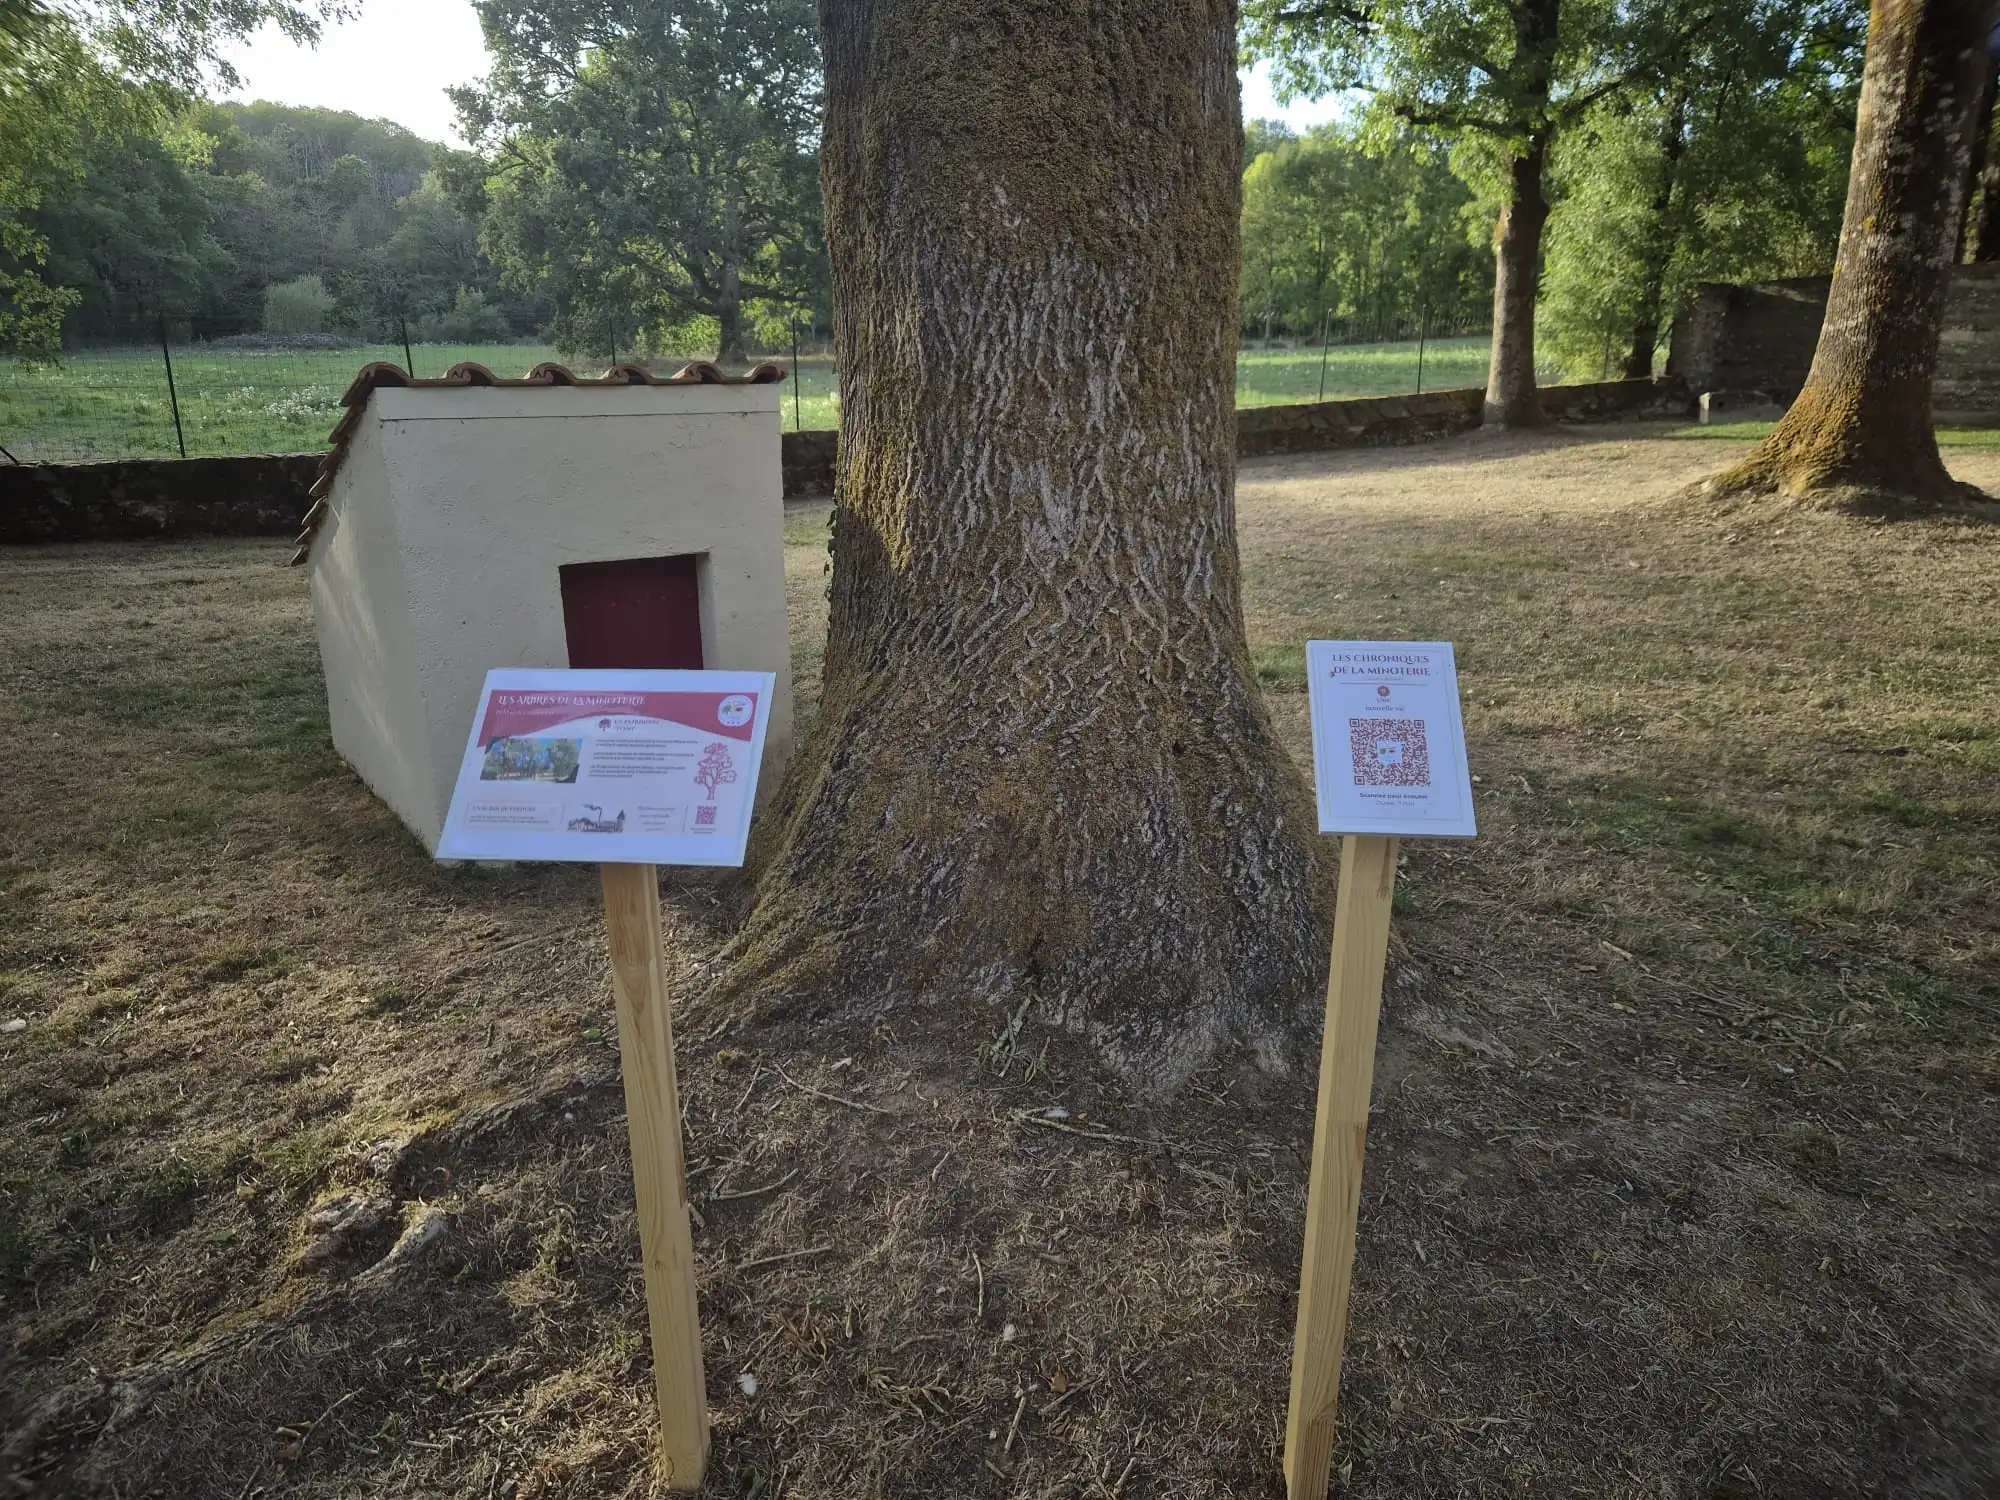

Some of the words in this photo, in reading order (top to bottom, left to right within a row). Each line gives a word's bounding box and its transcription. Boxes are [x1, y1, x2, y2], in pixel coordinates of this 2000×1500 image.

[1332, 653, 1351, 663] LES
[1353, 654, 1430, 665] CHRONIQUES
[1334, 666, 1348, 674] DE
[1351, 666, 1365, 675] LA
[1367, 667, 1430, 677] MINOTERIE
